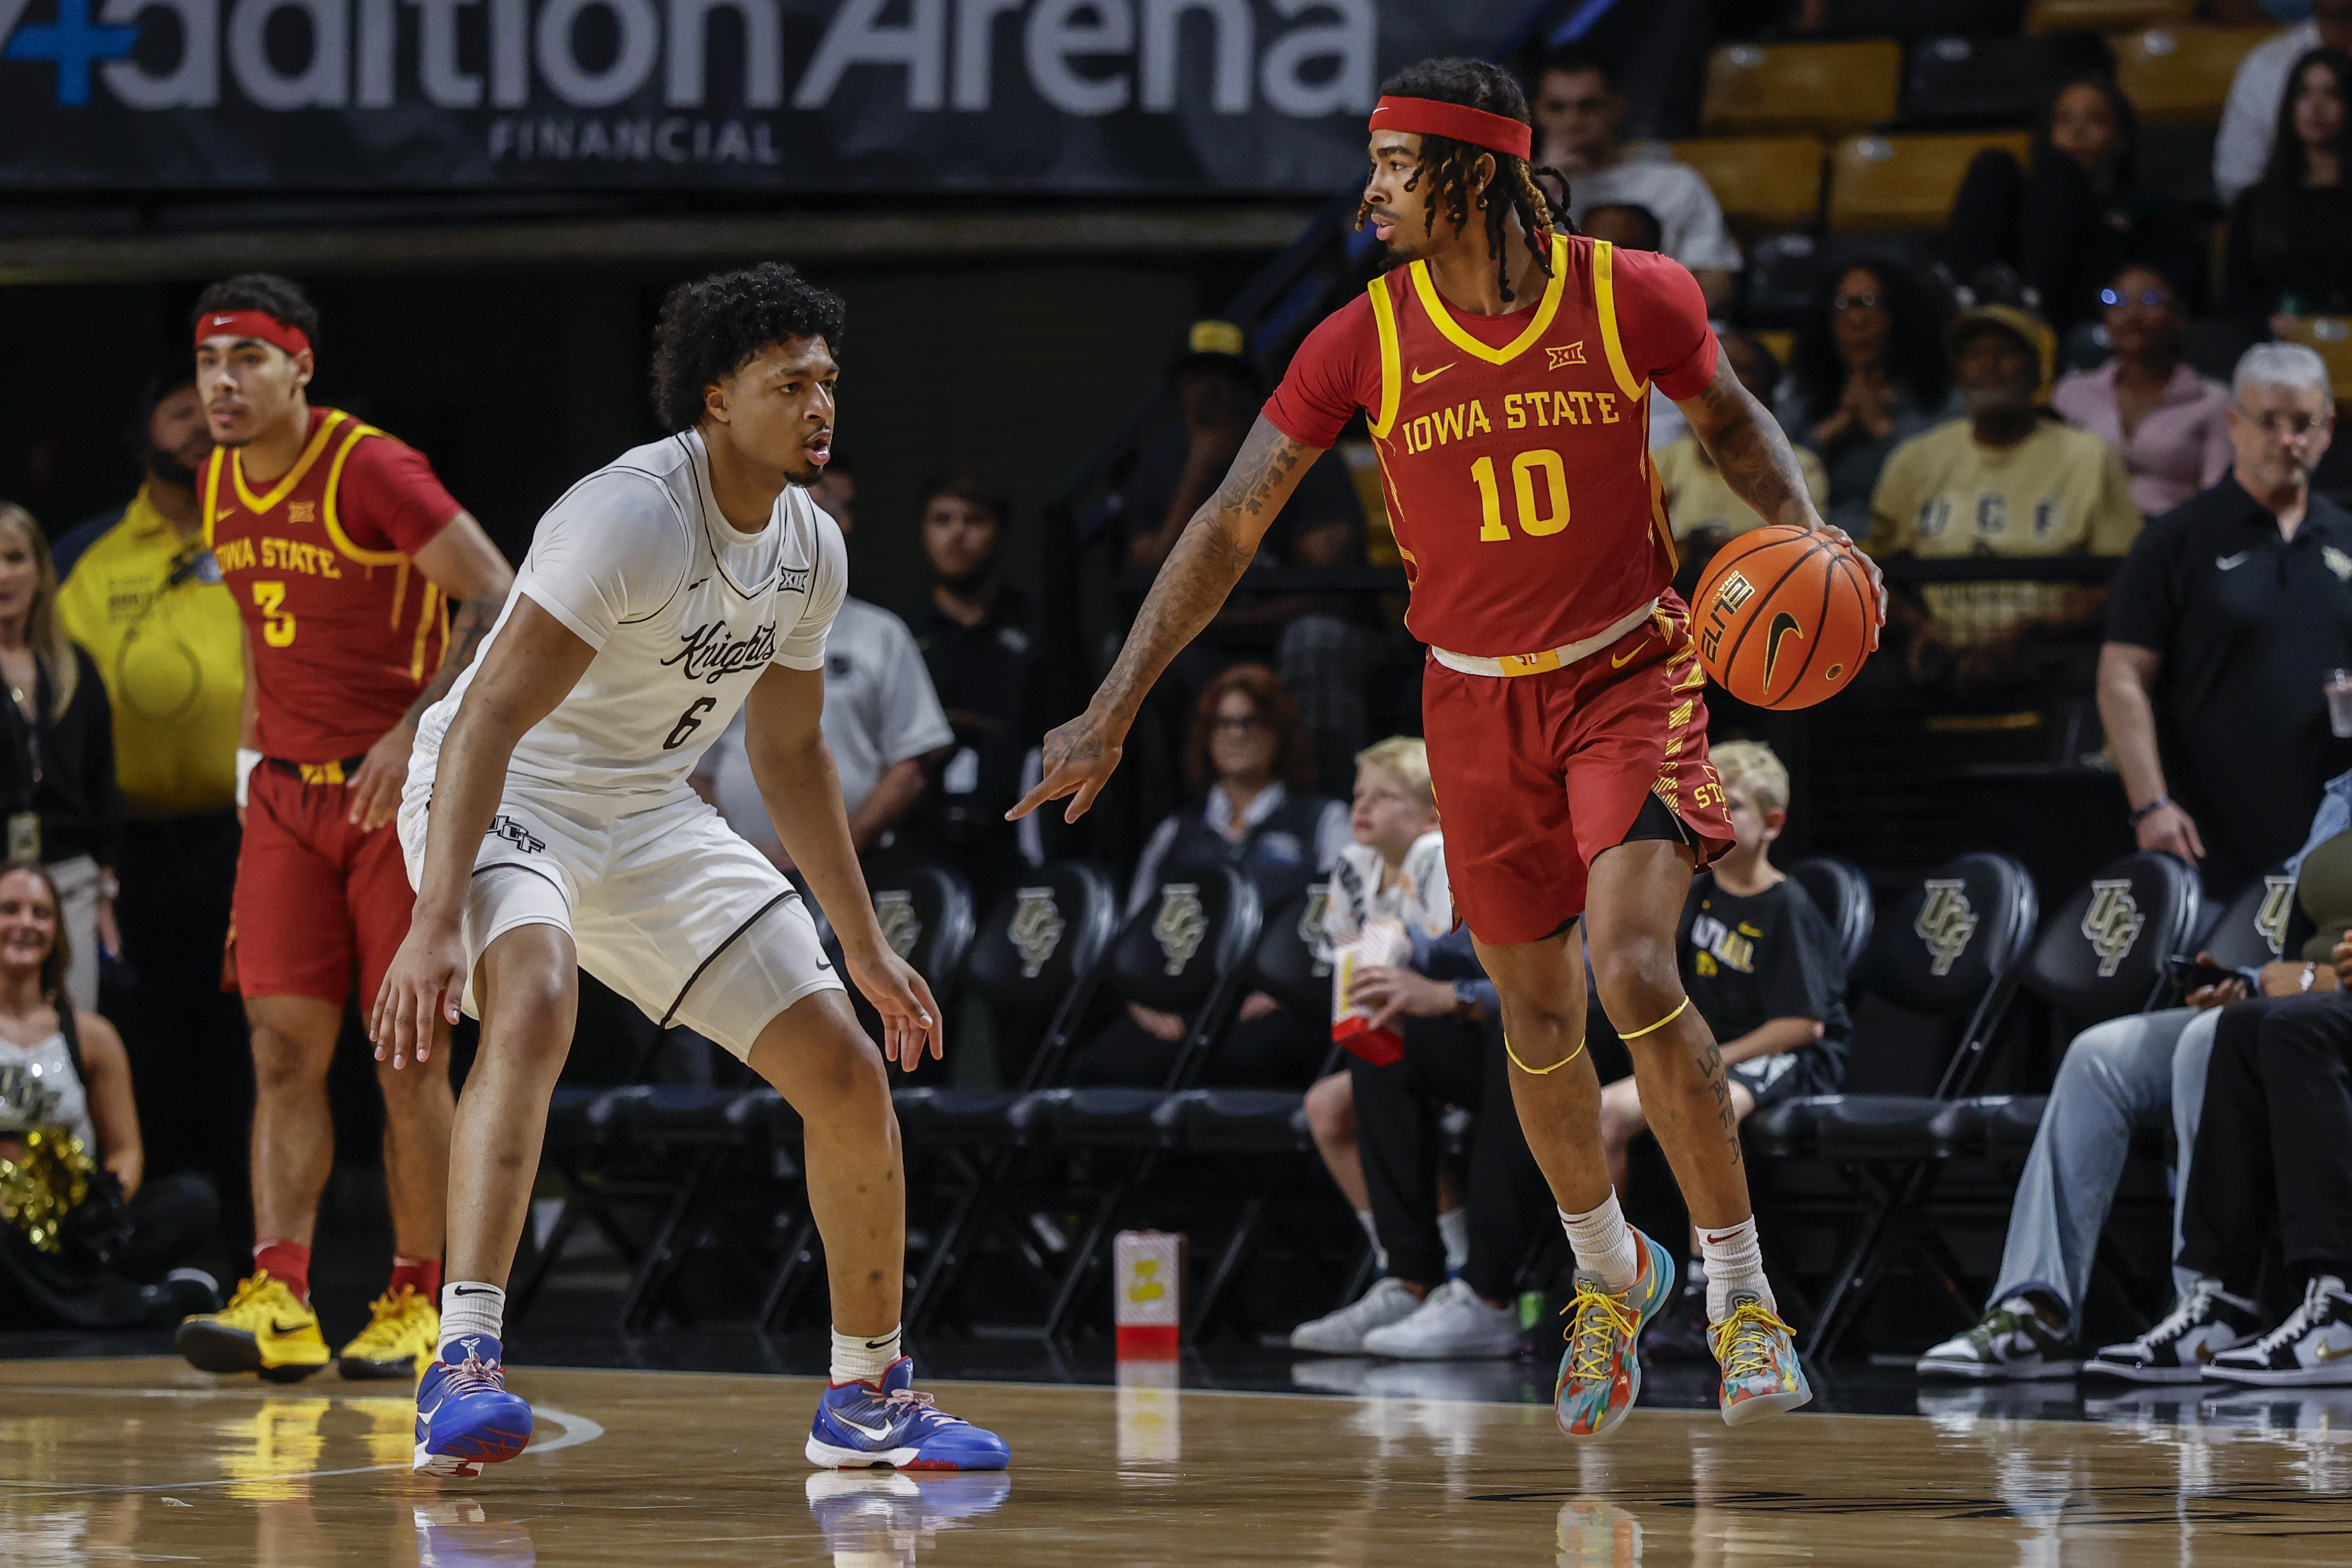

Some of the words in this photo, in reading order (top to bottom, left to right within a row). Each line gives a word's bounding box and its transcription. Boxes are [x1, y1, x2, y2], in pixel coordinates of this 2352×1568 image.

[789, 0, 1378, 115] Arena
[487, 117, 782, 163] FINANCIAL
[1403, 400, 1491, 455] IOWA
[1504, 391, 1620, 429] STATE
[1471, 449, 1571, 542] 10
[261, 536, 342, 579] STATE
[252, 580, 296, 648] 3
[1700, 575, 1755, 664] ELITE
[660, 620, 776, 684] Knights
[662, 697, 717, 749] 6
